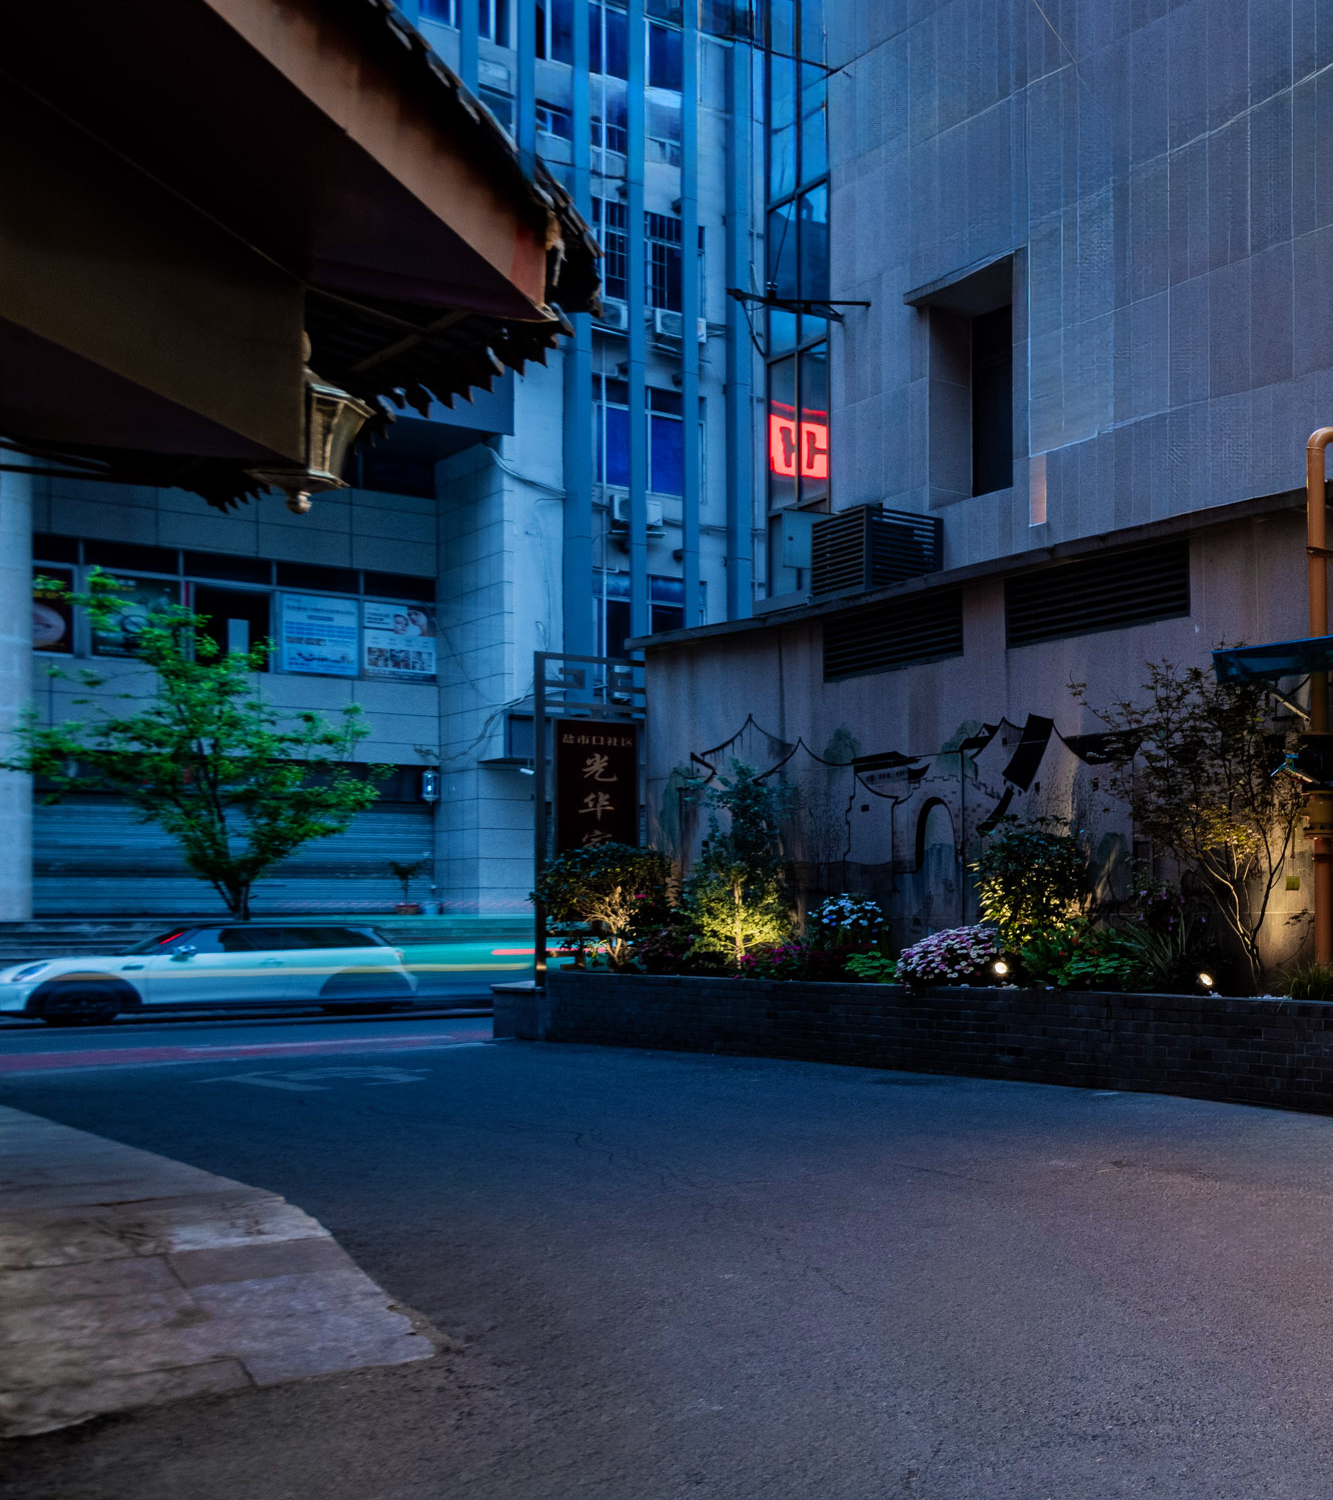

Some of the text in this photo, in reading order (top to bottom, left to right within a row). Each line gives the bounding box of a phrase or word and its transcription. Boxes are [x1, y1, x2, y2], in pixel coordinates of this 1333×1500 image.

[562, 733, 633, 748] 盐市口社区
